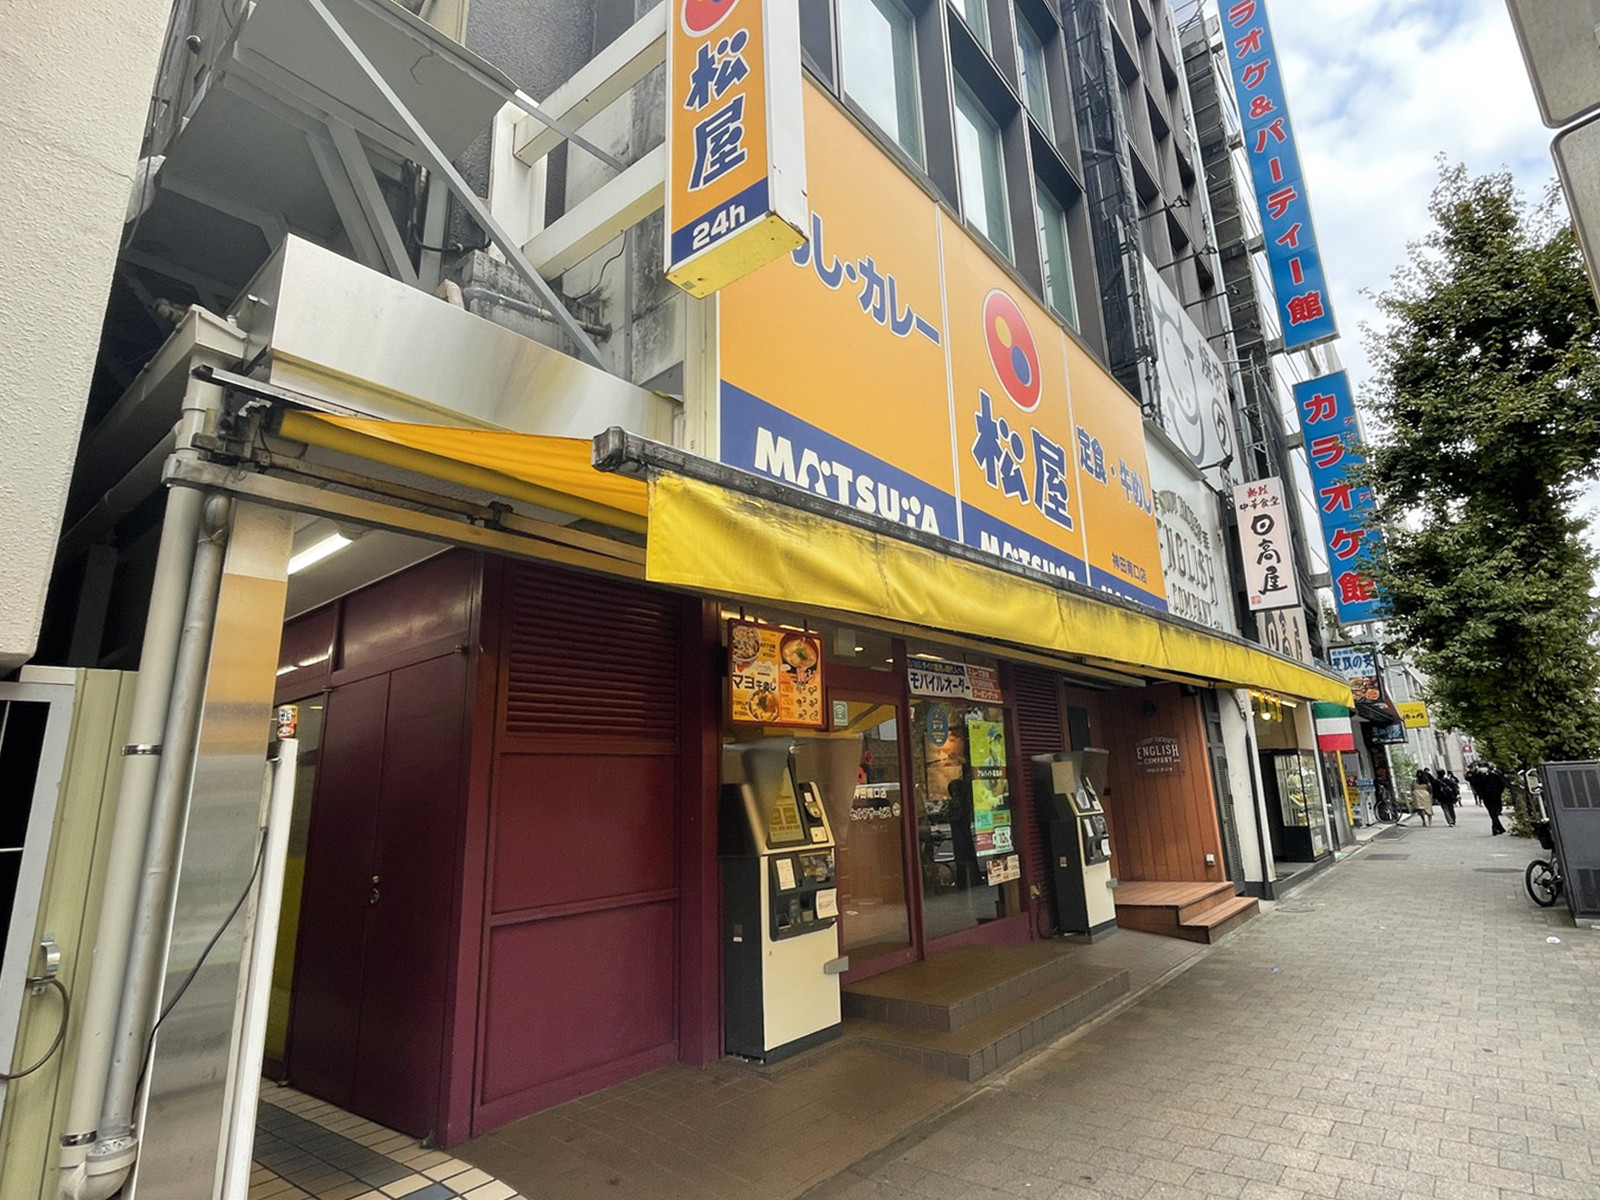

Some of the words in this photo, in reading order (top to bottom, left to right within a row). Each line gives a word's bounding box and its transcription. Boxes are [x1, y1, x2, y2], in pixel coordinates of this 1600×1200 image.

[684, 28, 750, 193] 松屋
[692, 203, 746, 250] 24h
[971, 388, 1075, 533] 松屋
[1075, 423, 1153, 516] 定食・牛めし
[1303, 392, 1381, 606] カラオケ館
[1239, 495, 1280, 511] 中華食堂
[1250, 513, 1289, 596] 日高屋
[1136, 744, 1179, 760] ENGLISH
[1143, 757, 1173, 765] COMPANY
